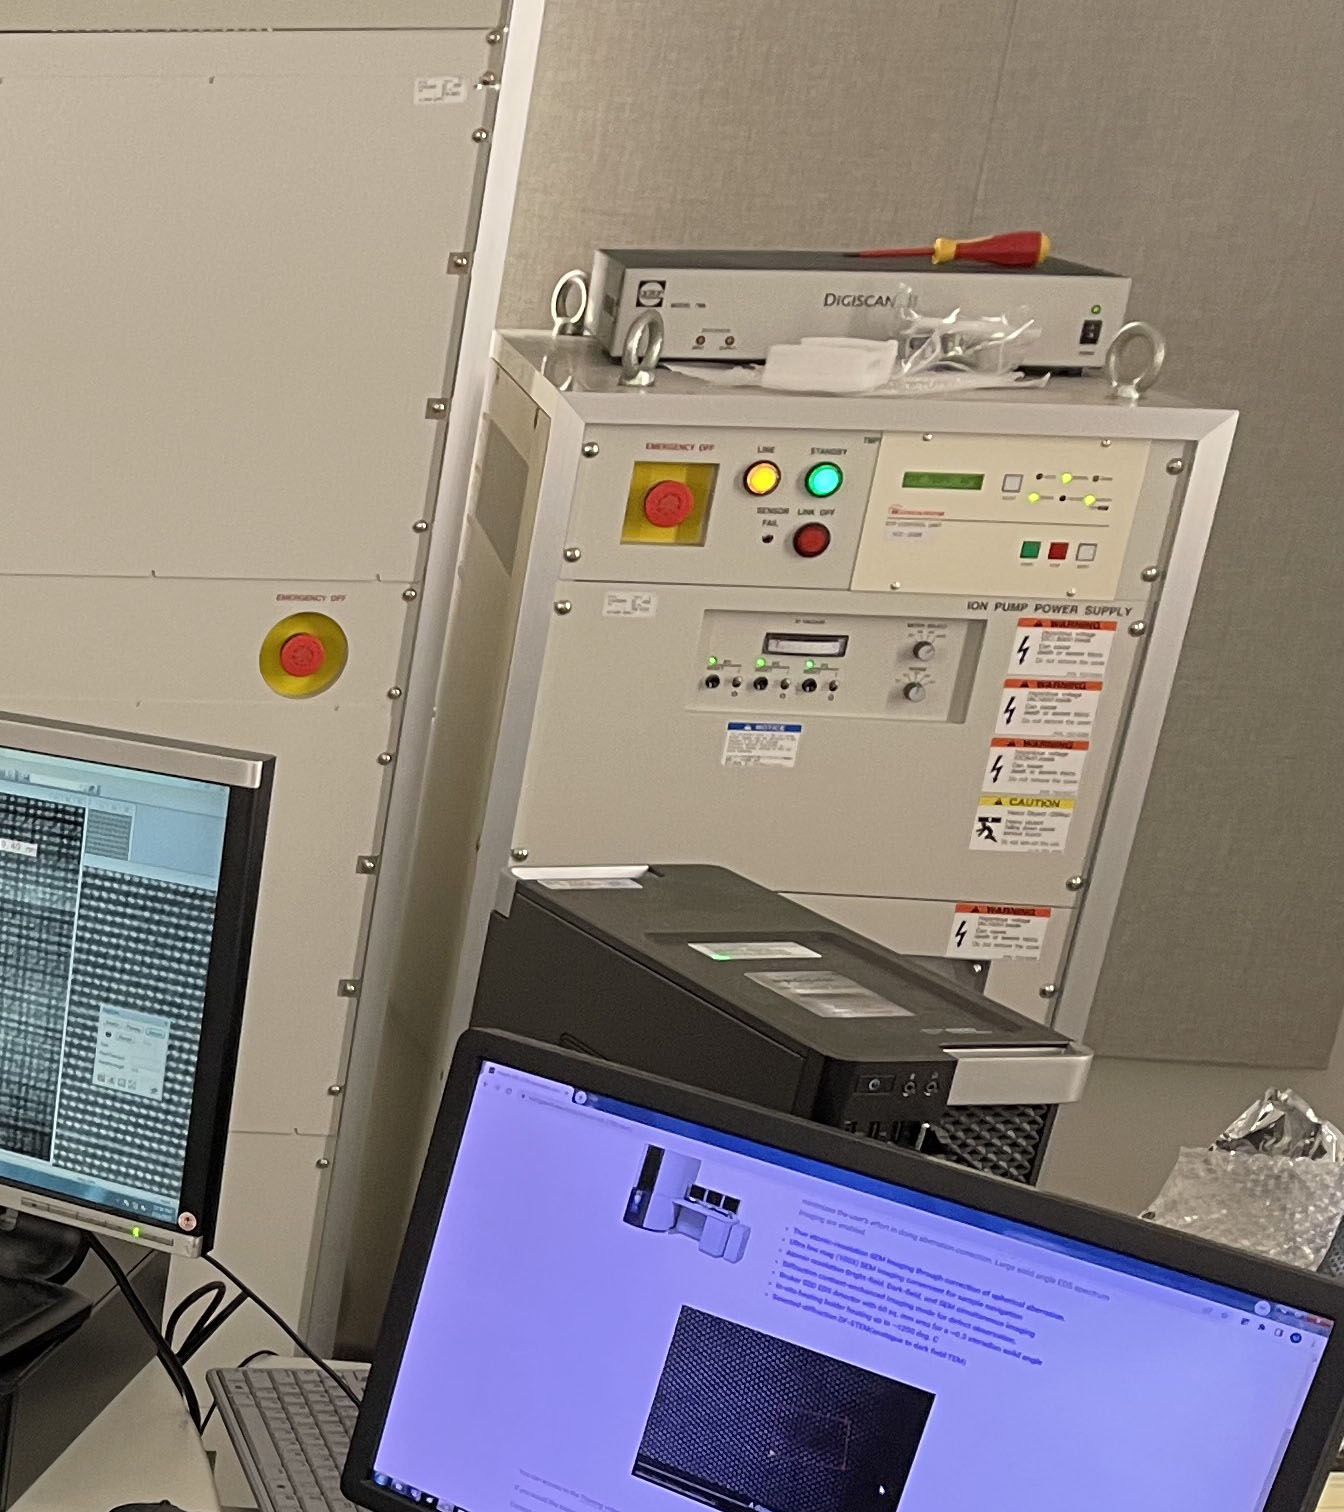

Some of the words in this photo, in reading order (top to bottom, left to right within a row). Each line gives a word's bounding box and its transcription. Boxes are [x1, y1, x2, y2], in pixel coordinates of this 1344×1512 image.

[645, 443, 695, 451] EMERGENCY
[811, 447, 847, 455] STANDBY
[967, 601, 988, 610] ION
[994, 602, 1028, 612] PUMP
[1034, 604, 1078, 614] POWER
[1085, 605, 1133, 616] SUPPLY
[1050, 619, 1100, 629] WARNING
[1037, 680, 1087, 690] WARNING
[1009, 798, 1060, 807] CAUTION
[995, 1259, 1015, 1271] Large
[933, 1335, 940, 1343] C
[1022, 1355, 1042, 1365] angle
